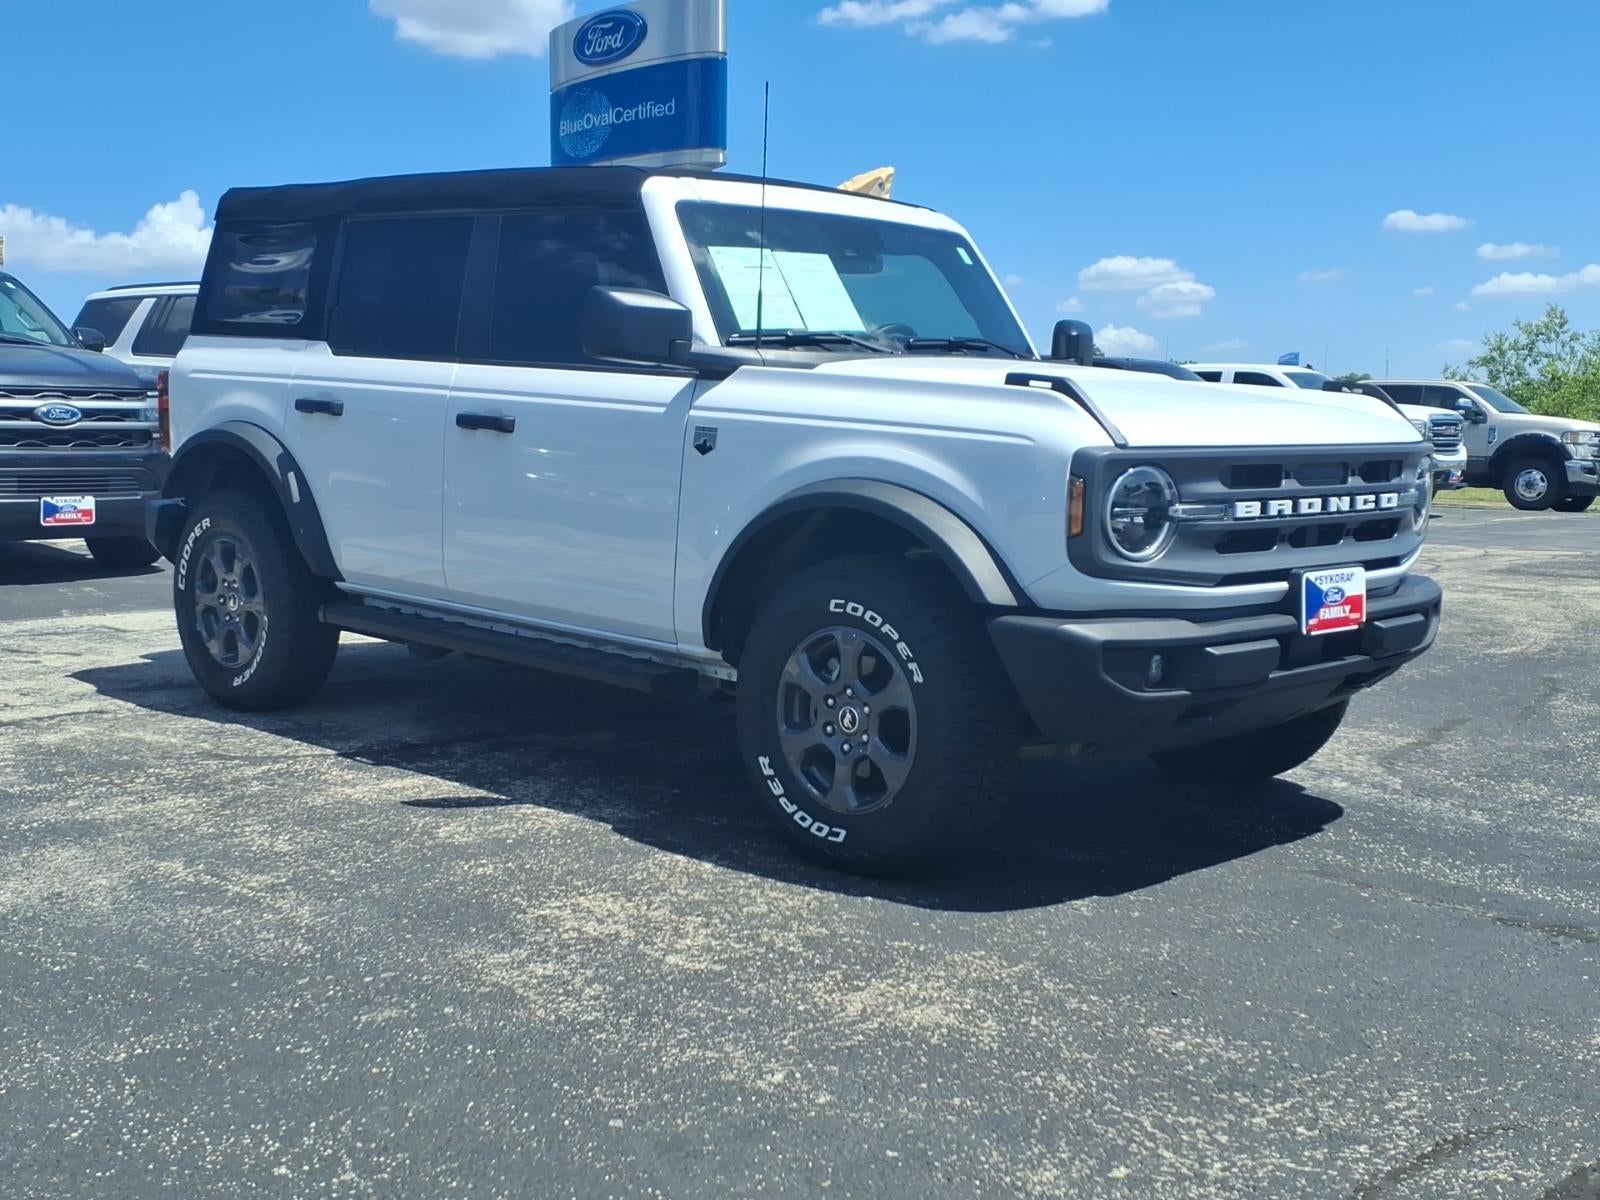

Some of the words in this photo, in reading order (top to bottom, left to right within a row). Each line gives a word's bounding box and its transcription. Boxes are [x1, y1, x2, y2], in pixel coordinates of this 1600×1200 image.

[584, 21, 625, 55] Ford
[559, 97, 676, 136] BlueOvalCertified
[49, 408, 71, 419] Ford
[1234, 492, 1399, 518] BRONCO
[178, 517, 211, 590] COOPER
[1319, 604, 1351, 620] FAMILY
[1326, 588, 1342, 602] Ford
[232, 615, 269, 687] COOPER
[829, 599, 924, 684] COOPER
[758, 755, 847, 843] COOPER
